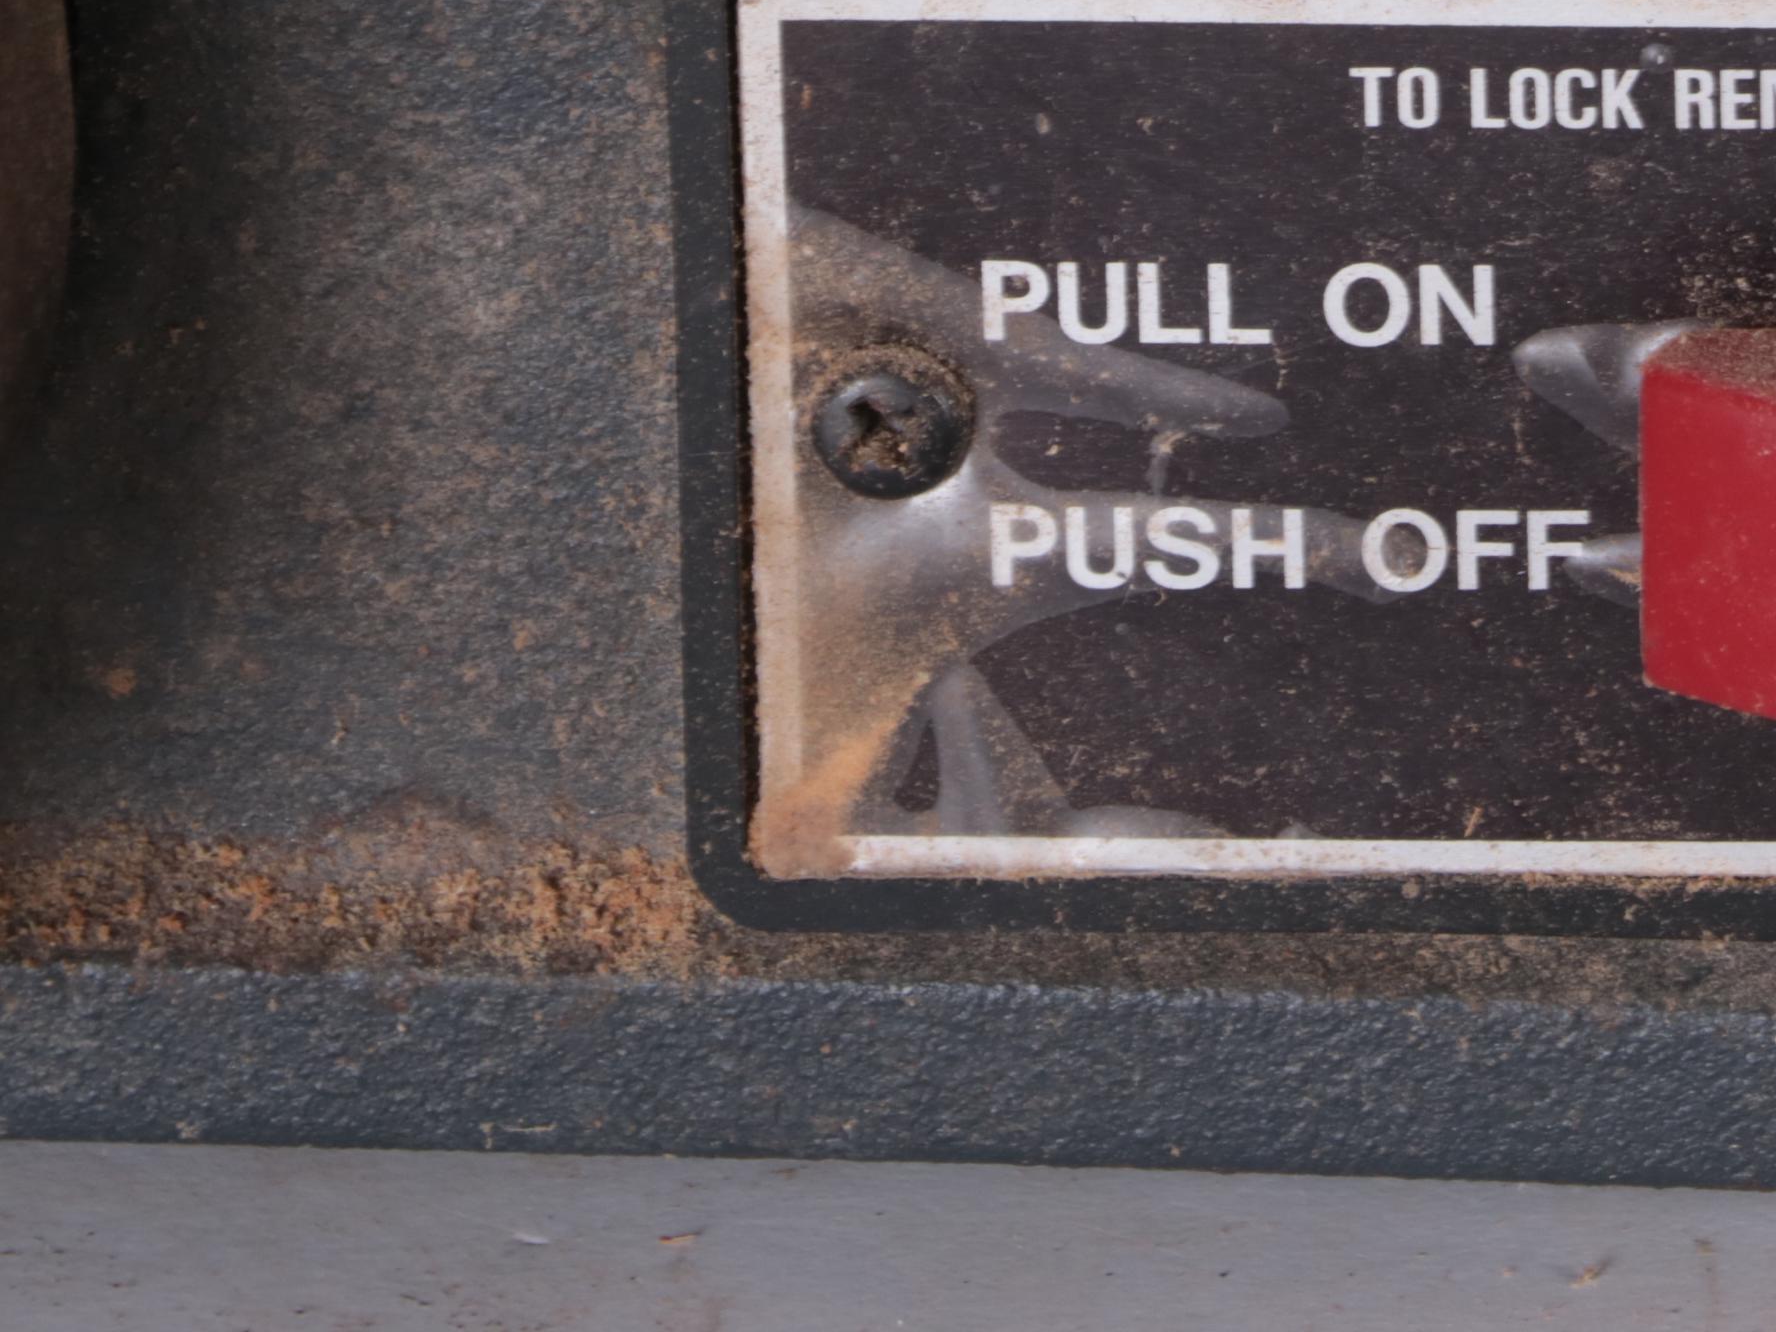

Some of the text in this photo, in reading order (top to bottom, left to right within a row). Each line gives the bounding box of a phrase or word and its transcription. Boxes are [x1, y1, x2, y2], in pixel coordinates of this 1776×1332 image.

[1352, 66, 1439, 129] TO
[1470, 67, 1643, 130] LOCK
[981, 260, 1495, 347] PULL ON
[988, 504, 1592, 592] PUSH OFF
